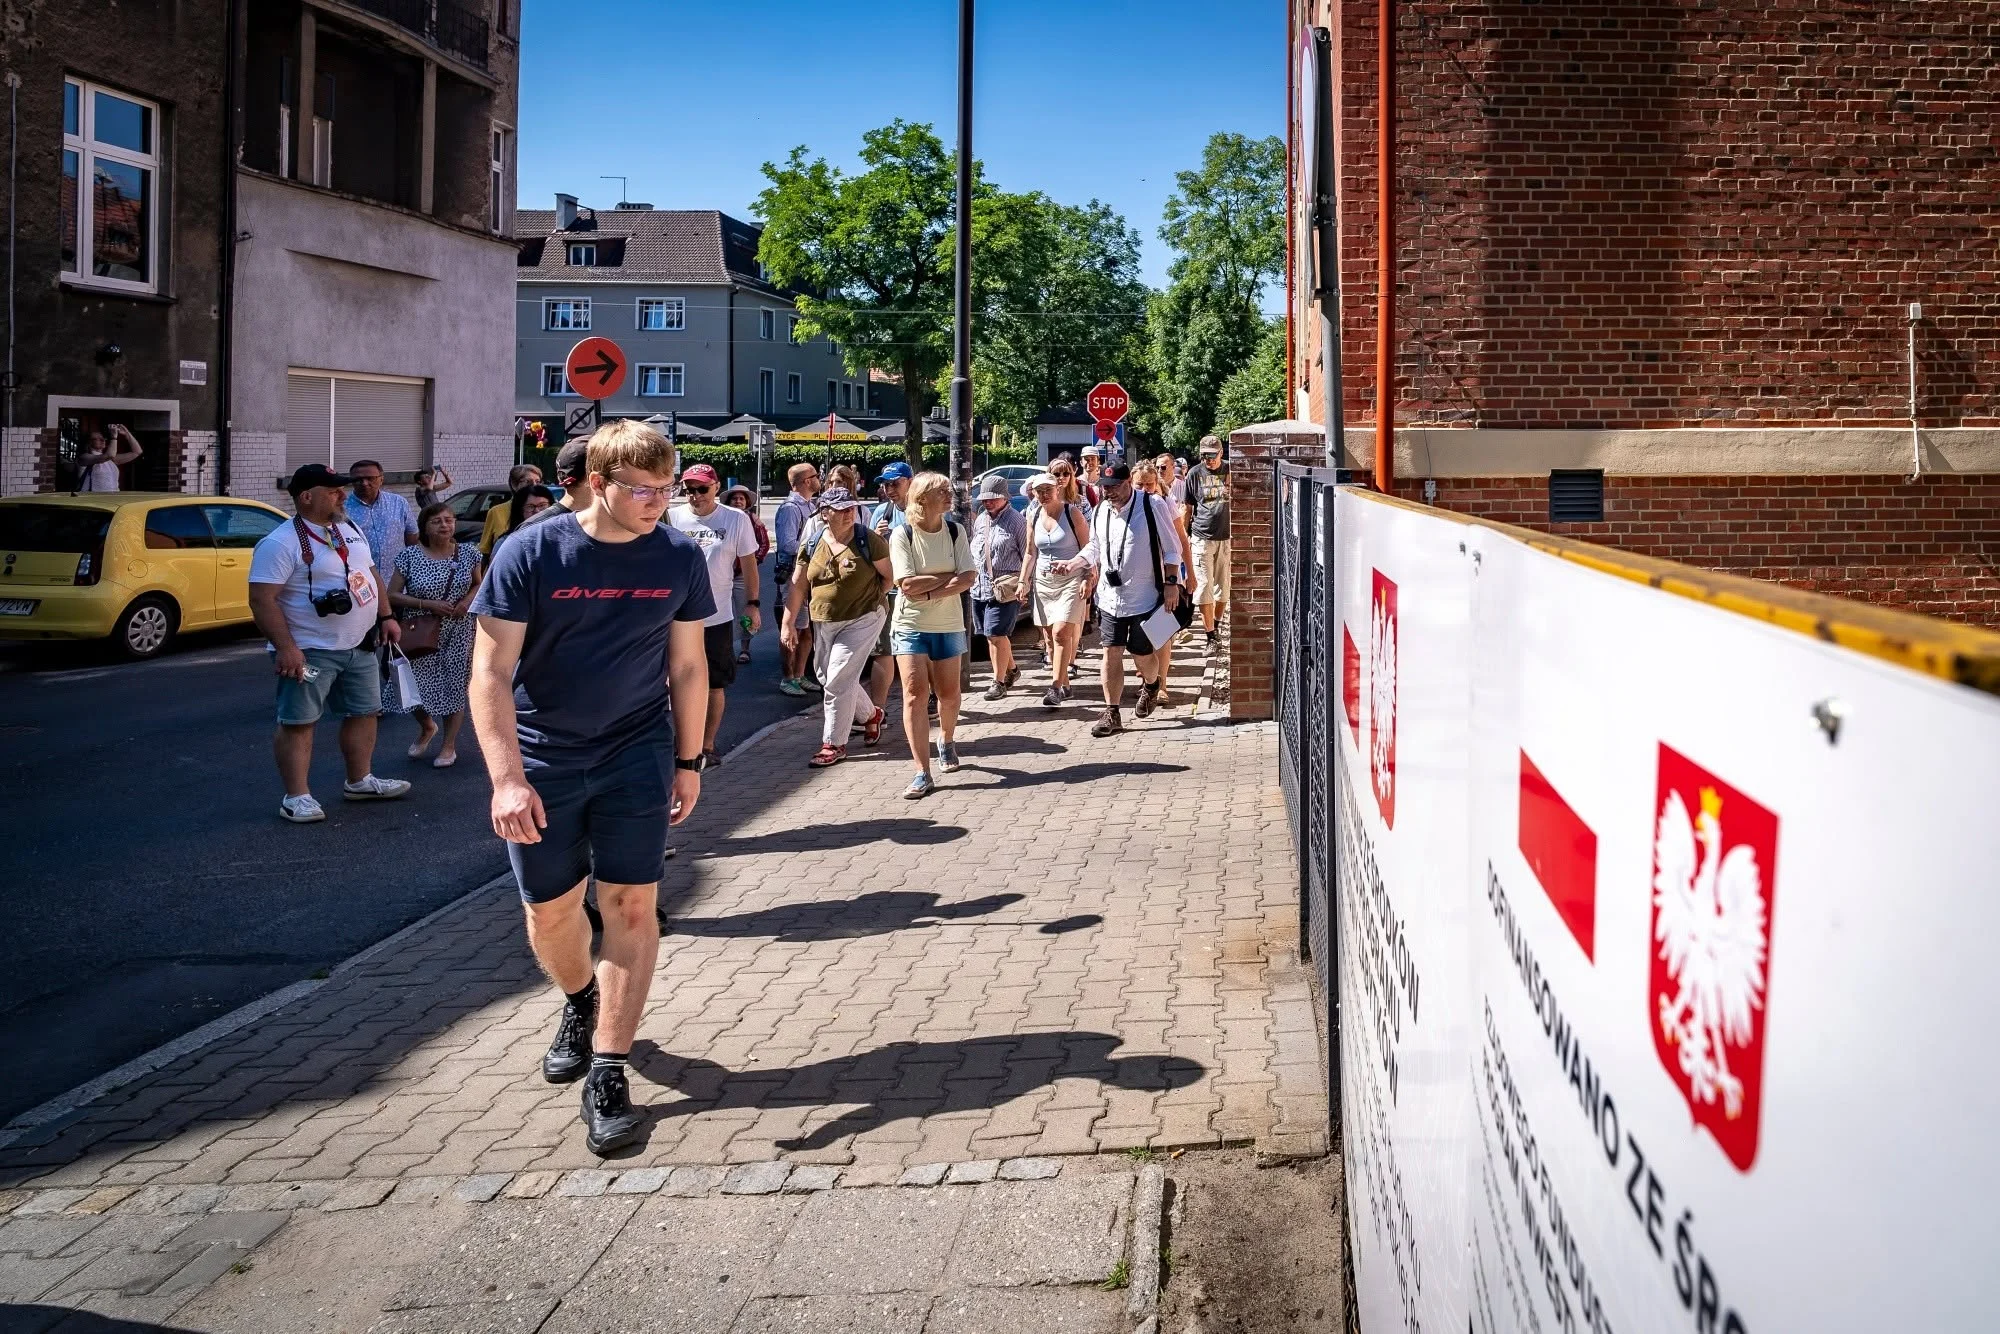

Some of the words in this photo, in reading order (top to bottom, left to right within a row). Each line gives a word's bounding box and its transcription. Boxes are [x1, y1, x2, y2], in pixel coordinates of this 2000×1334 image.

[1093, 397, 1125, 409] STOP
[551, 586, 672, 599] diverse
[1359, 869, 1400, 1044] PROGRAMU
[1359, 921, 1399, 1110] ZABYTKÓW
[1371, 840, 1420, 1025] ŚRODKÓW
[1487, 857, 1619, 1169] DOFINANSOWANO
[1626, 1132, 1665, 1260] ZE
[1388, 1123, 1420, 1297] budynku
